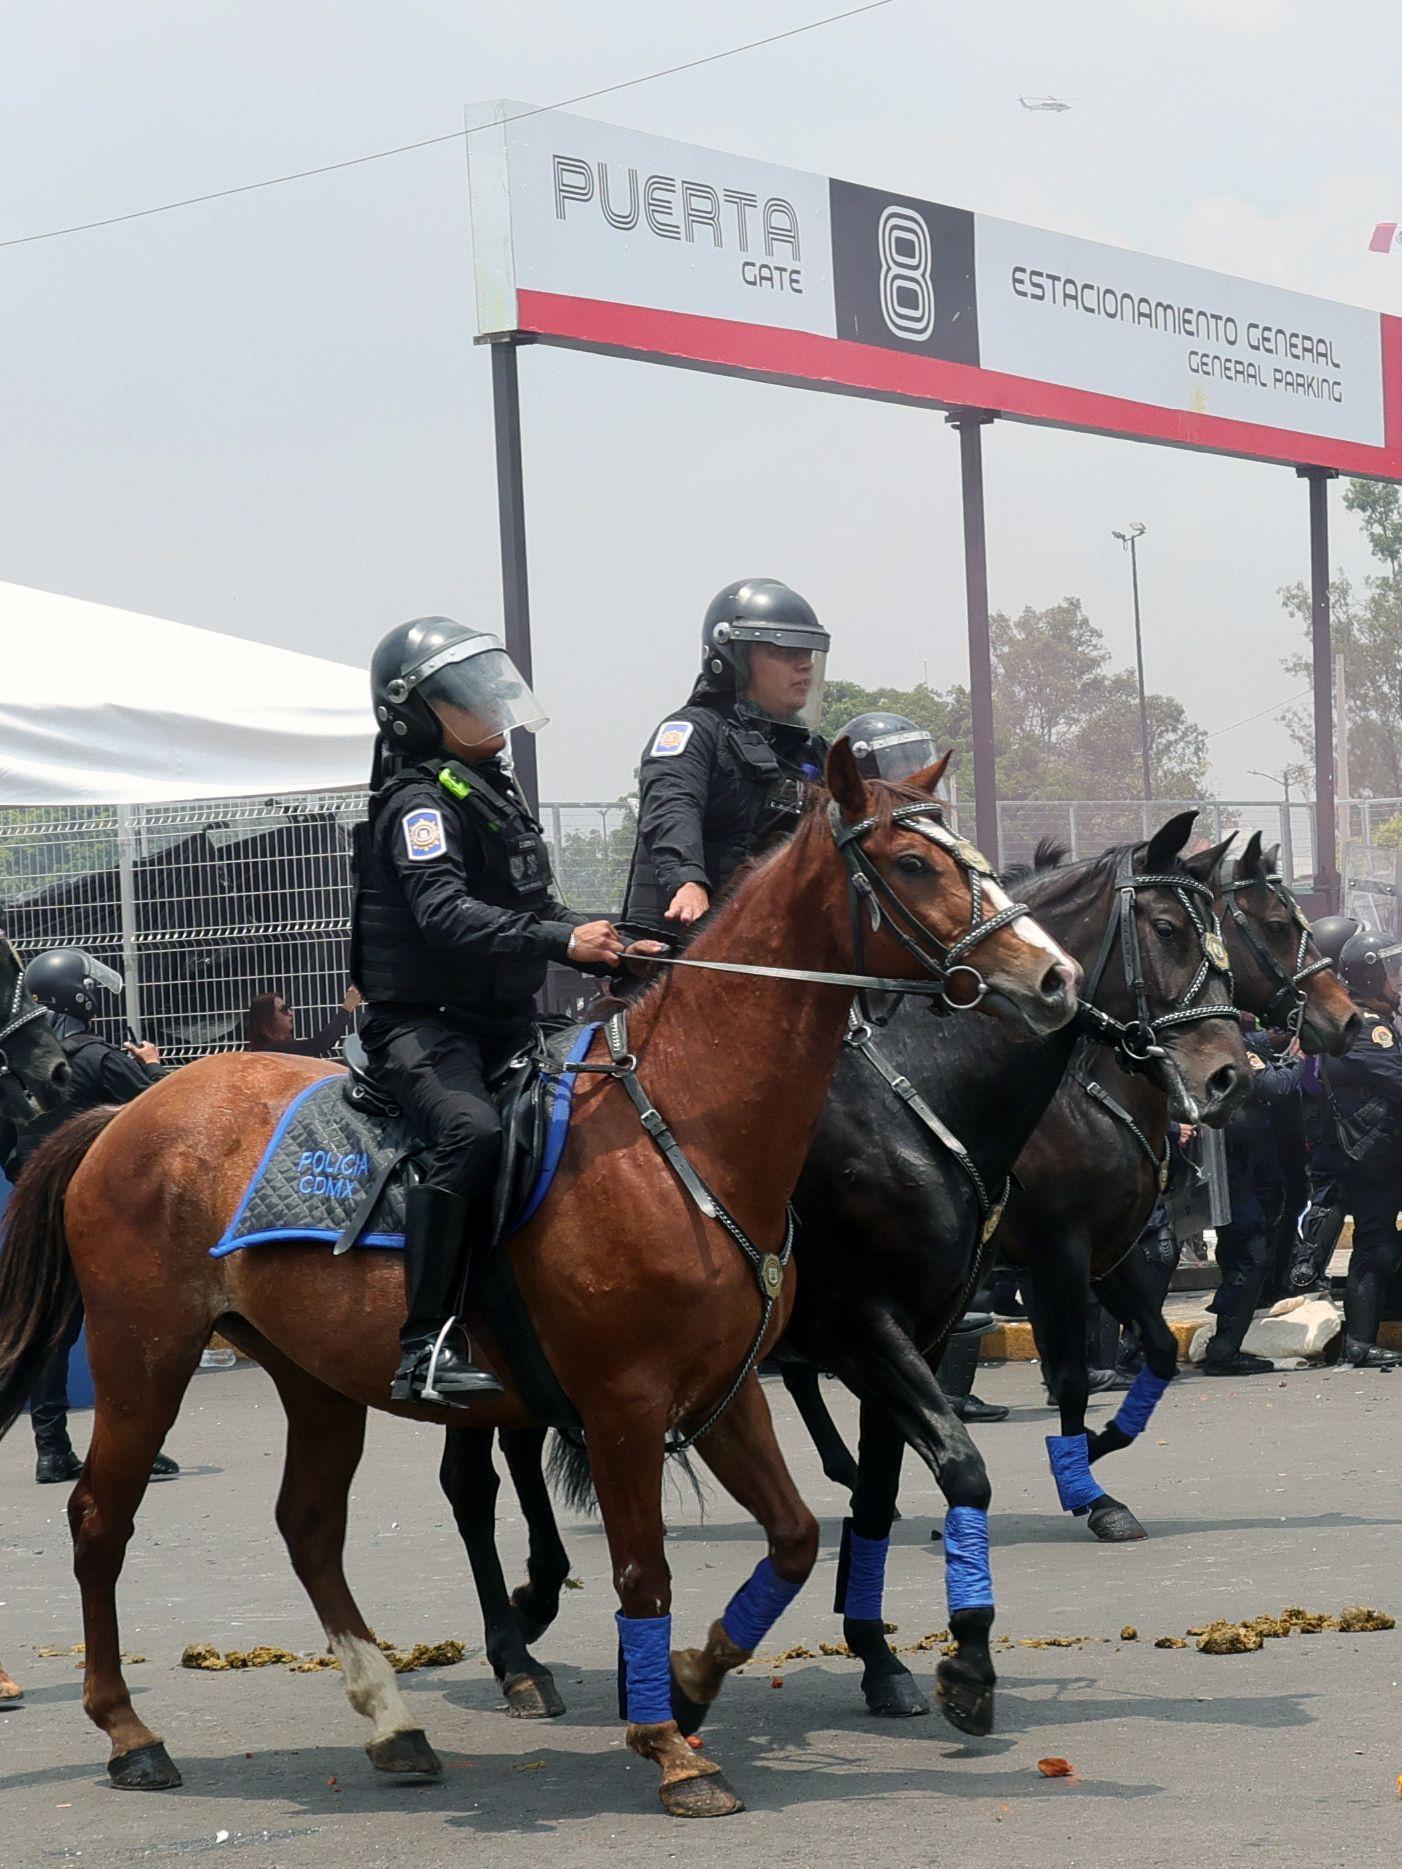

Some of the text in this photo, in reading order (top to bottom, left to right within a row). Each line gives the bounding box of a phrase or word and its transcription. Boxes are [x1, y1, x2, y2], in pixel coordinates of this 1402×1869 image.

[553, 153, 801, 262] PUERTA
[742, 261, 804, 295] GATE
[878, 205, 935, 342] 8
[1011, 265, 1341, 369] ESTACIONAMIENTO GENERAL
[1188, 350, 1343, 404] GENERAL PARKING
[298, 1150, 370, 1176] POLICIA
[299, 1175, 357, 1198] CDMX
